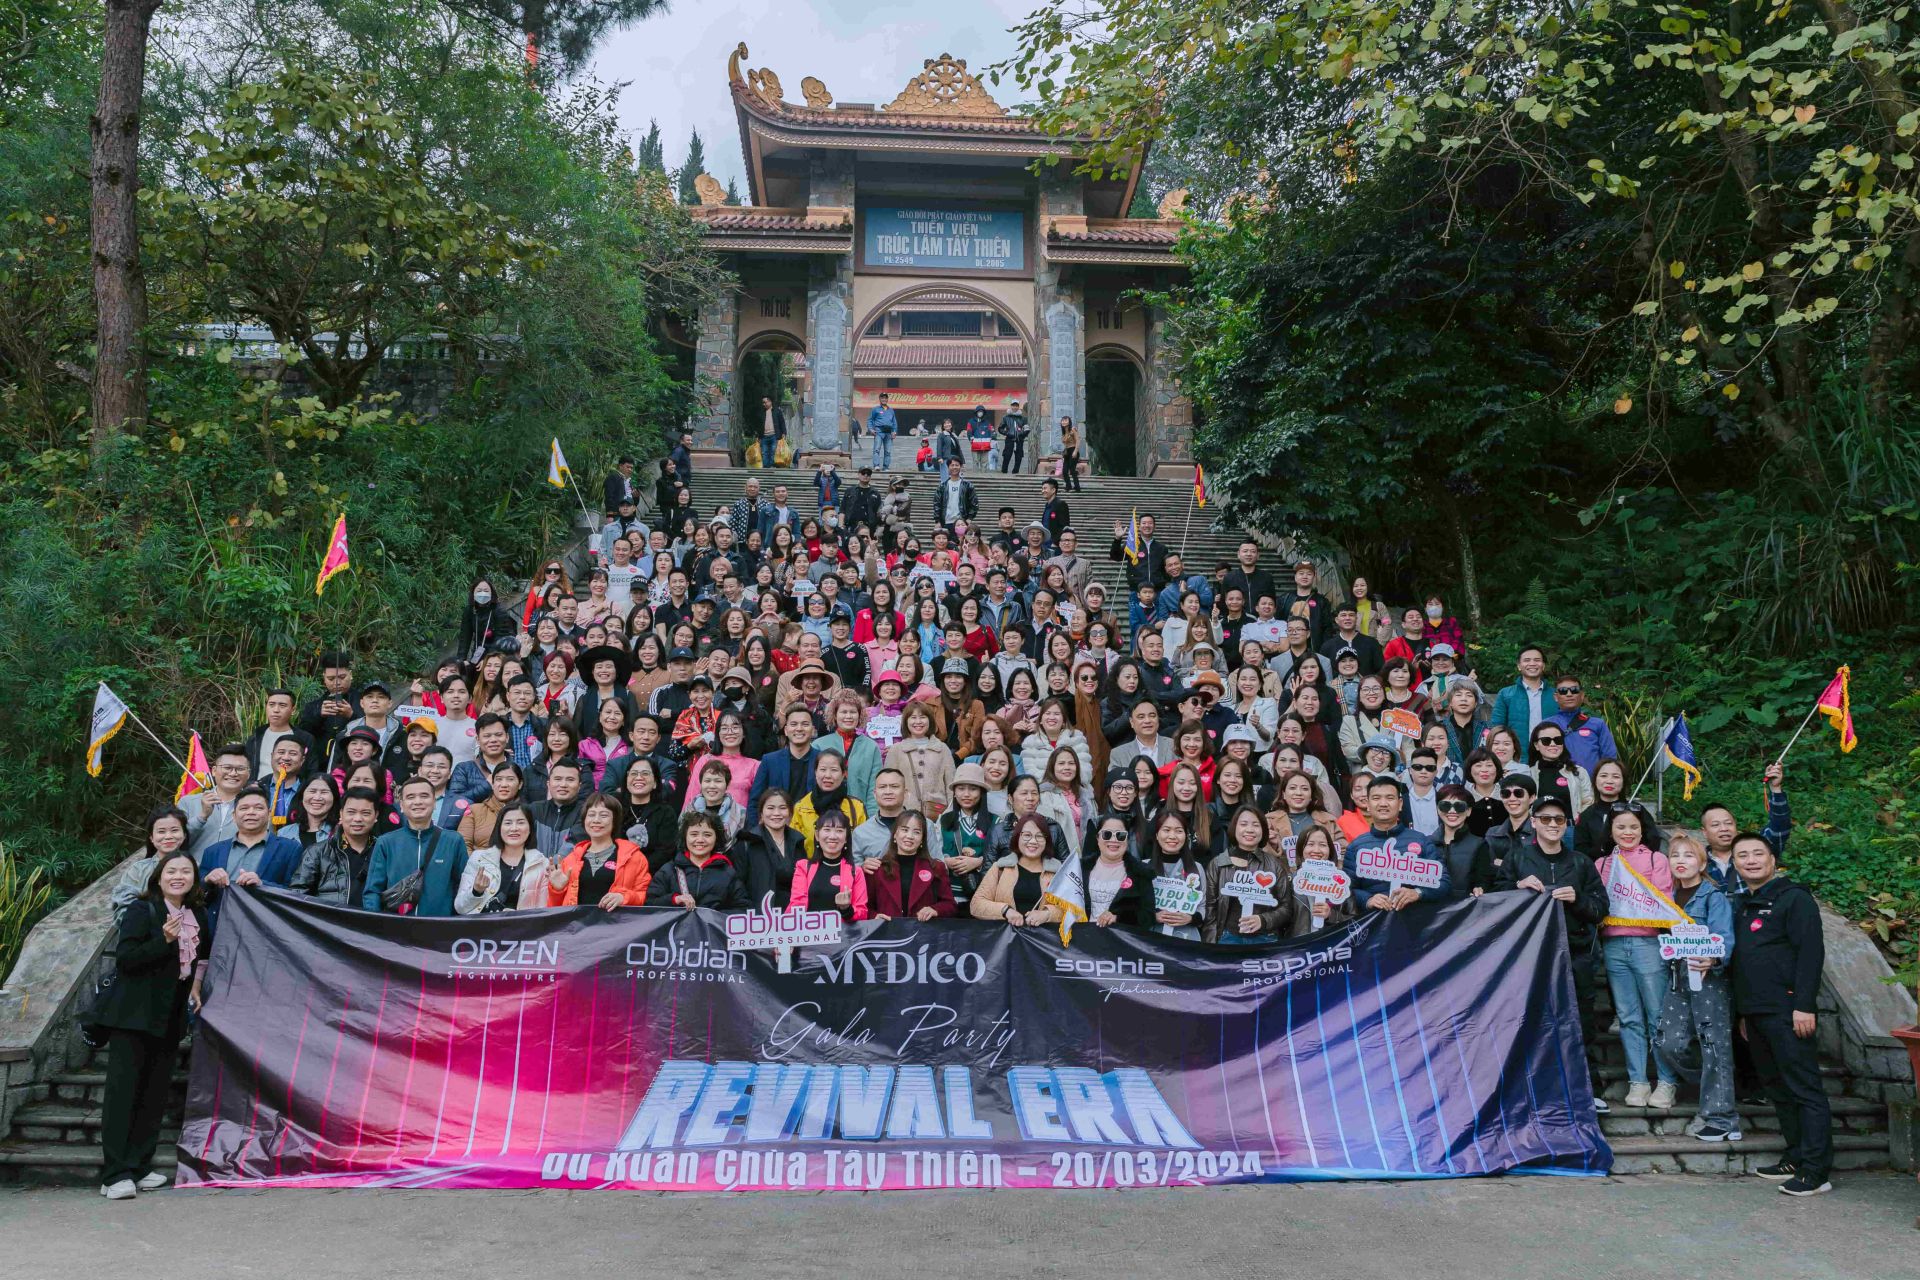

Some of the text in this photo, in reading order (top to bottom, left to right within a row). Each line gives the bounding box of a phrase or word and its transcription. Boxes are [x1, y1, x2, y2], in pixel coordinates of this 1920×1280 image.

[877, 232, 1011, 257] TRÚC LÂM TÂY THIÊN
[1235, 872, 1255, 885] We
[1360, 868, 1437, 885] PROFESSIONAL
[1227, 885, 1267, 895] sophia
[729, 933, 840, 947] PROFESSIONAL
[451, 938, 560, 965] ORZEN
[1240, 946, 1352, 977] sophia
[447, 970, 555, 983] SIGNATURE
[626, 969, 746, 984] PROFESSIONAL
[1055, 956, 1165, 977] sophia
[1243, 963, 1353, 987] PROFESSIONAL
[762, 1001, 1016, 1069] Gala Party
[615, 1060, 1205, 1150] REVIVAL ERA
[1051, 1150, 1265, 1187] 20/03/2024
